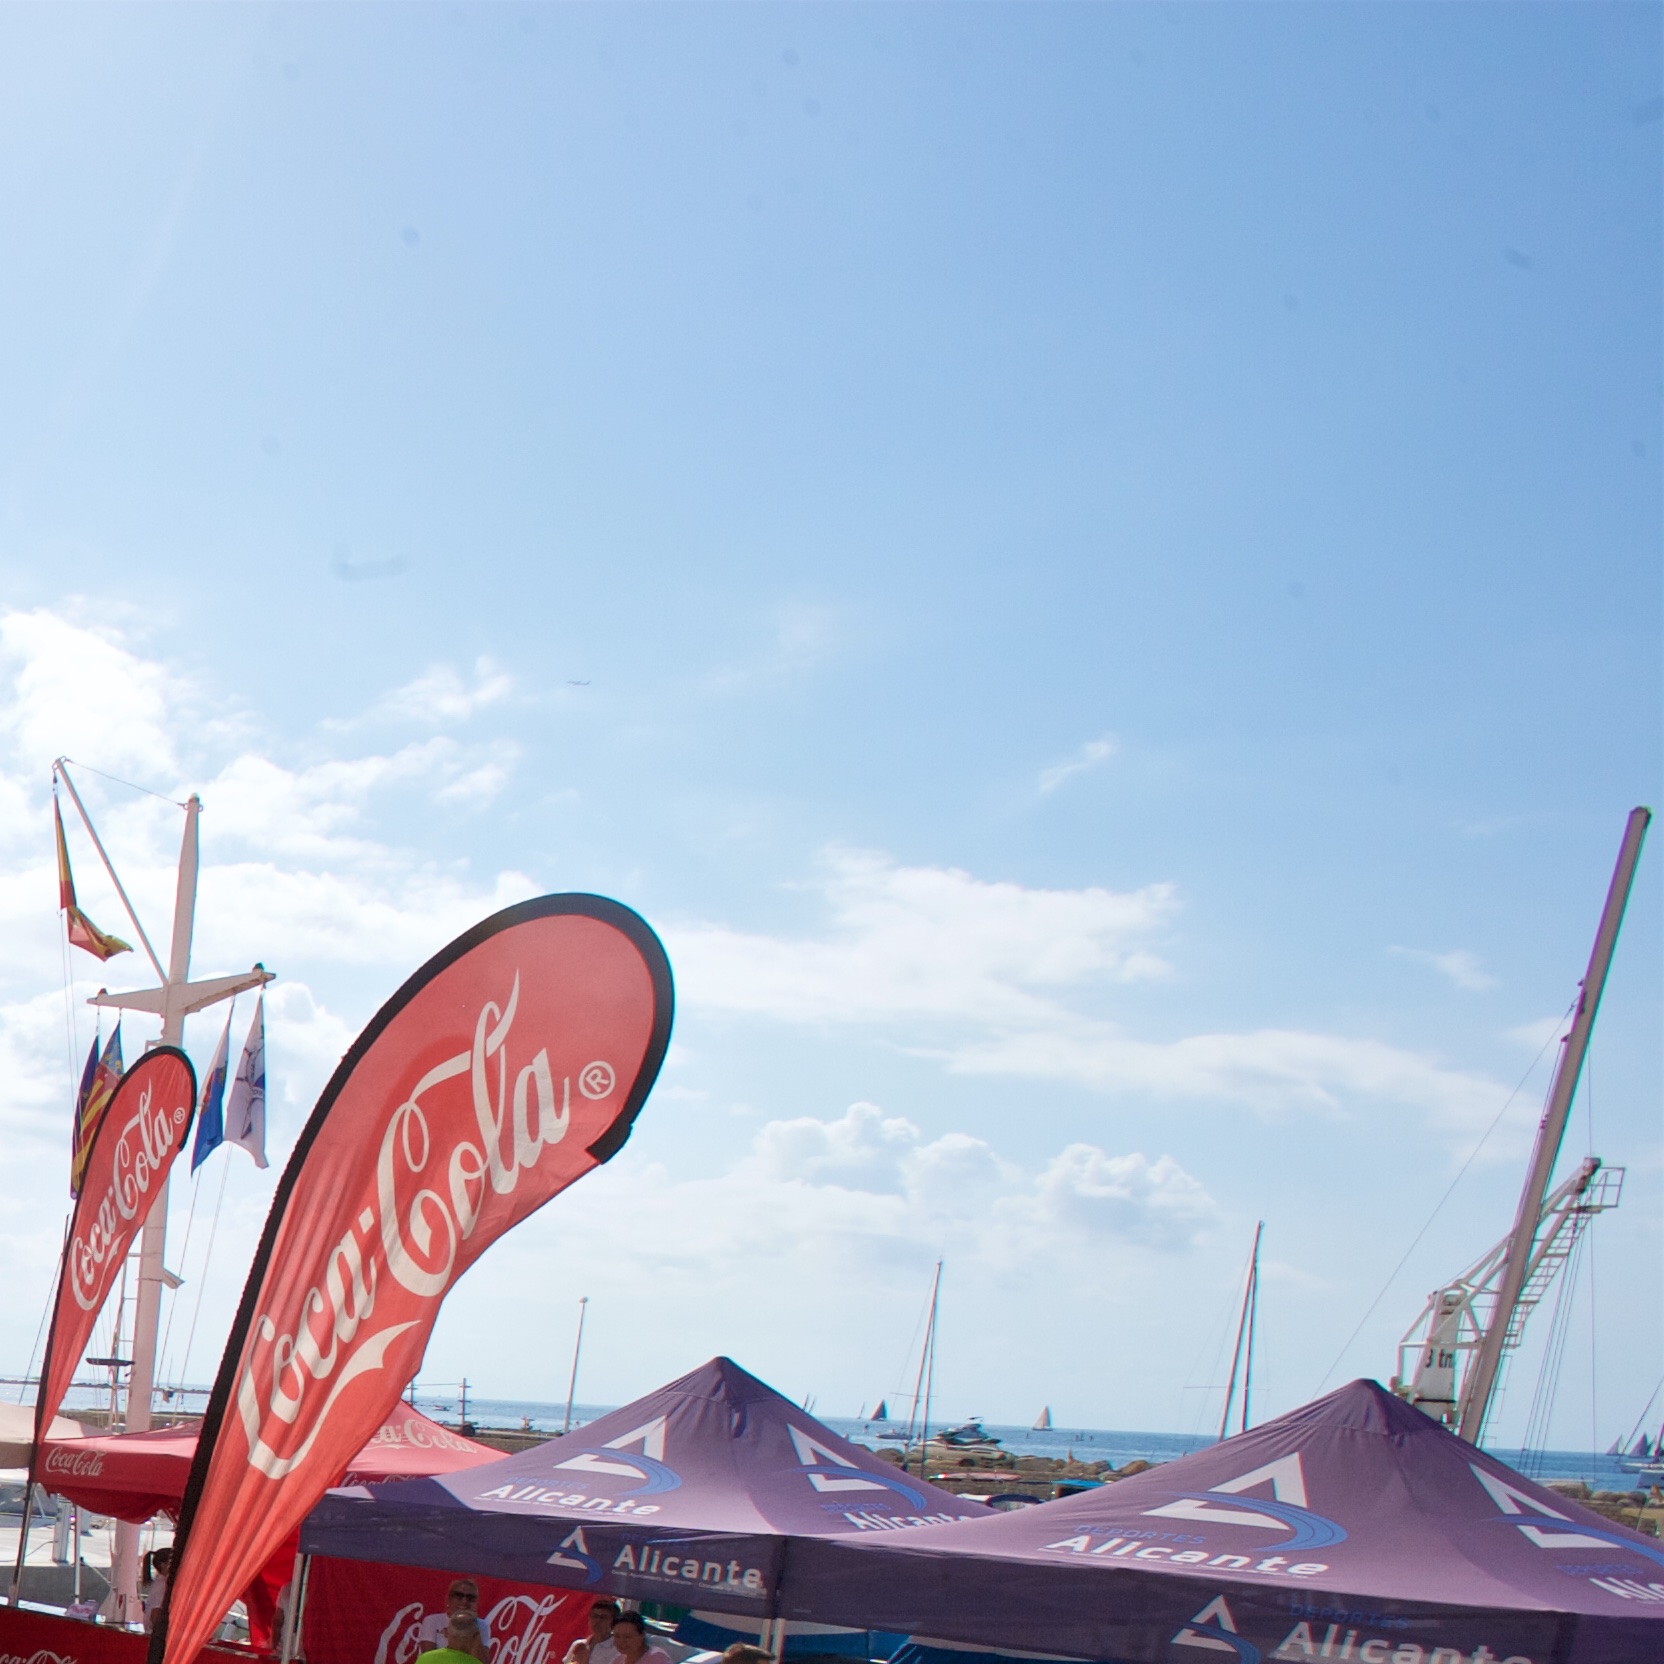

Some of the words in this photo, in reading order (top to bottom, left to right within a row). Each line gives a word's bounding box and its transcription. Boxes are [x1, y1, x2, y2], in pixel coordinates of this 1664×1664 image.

[71, 1078, 174, 1311] Coca-Cola
[238, 968, 570, 1479] Coca-Cola
[480, 1484, 663, 1517] Alicante
[613, 1544, 764, 1590] Alicante
[1044, 1534, 1330, 1576] Alicante
